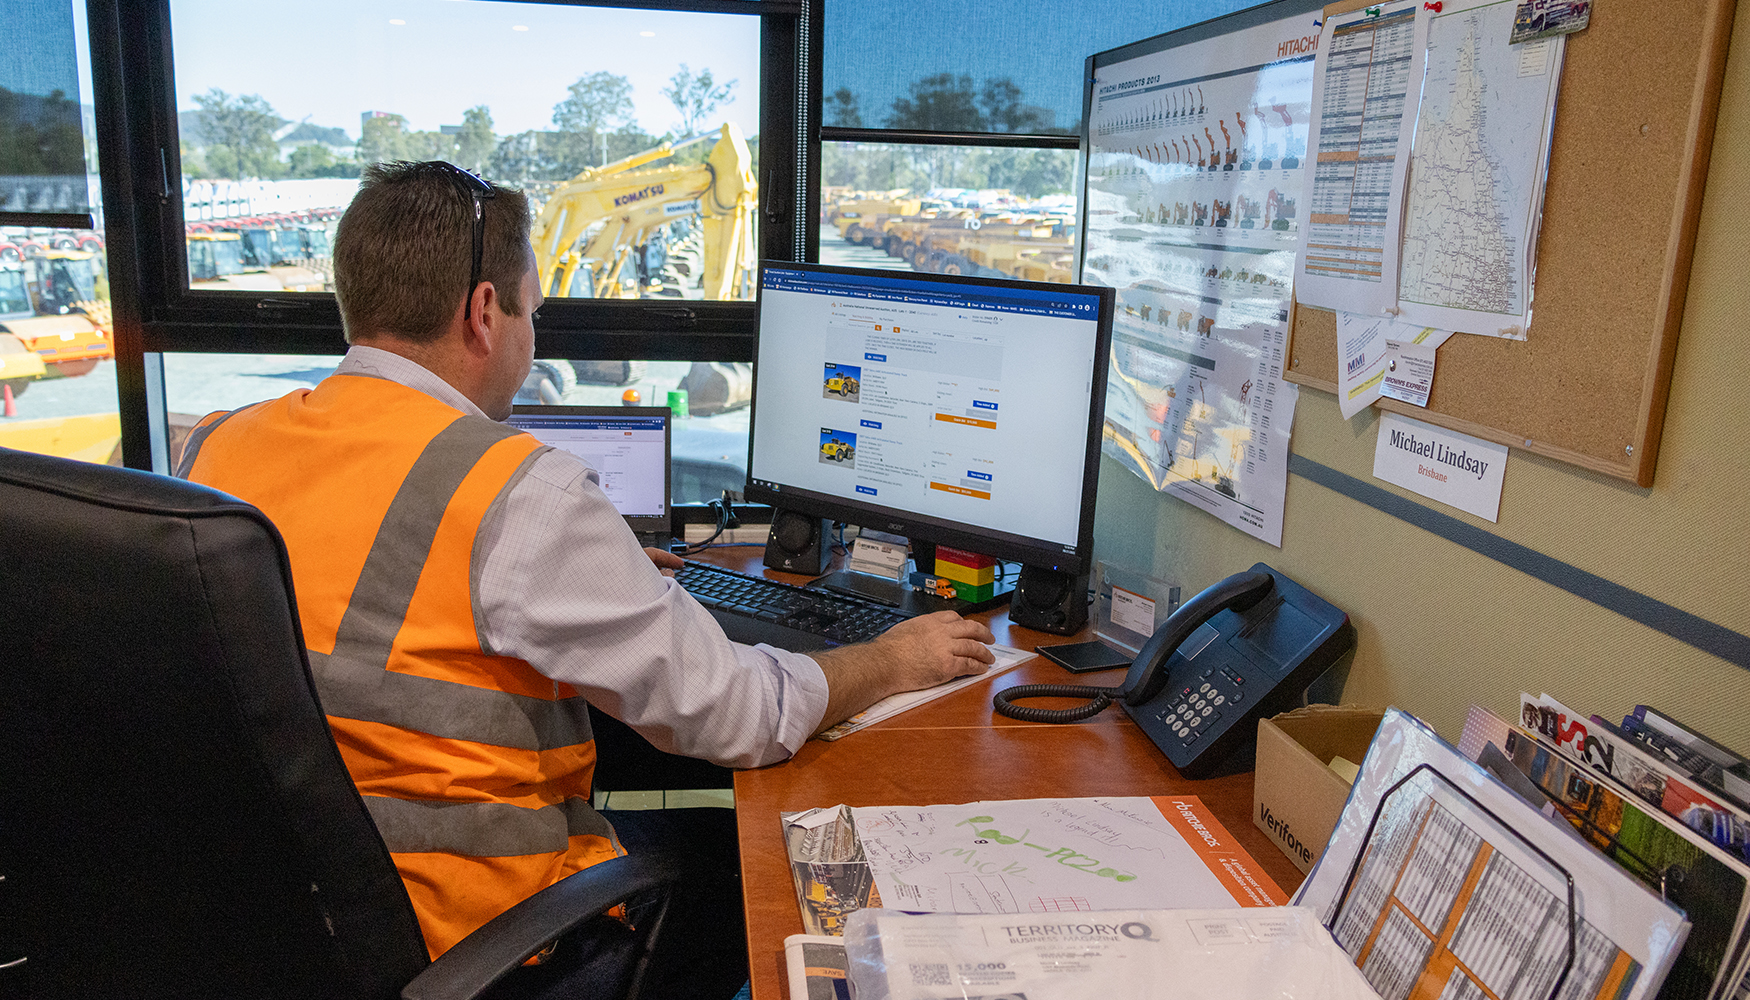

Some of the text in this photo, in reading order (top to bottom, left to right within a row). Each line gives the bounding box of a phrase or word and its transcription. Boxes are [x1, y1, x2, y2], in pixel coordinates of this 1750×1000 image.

[1277, 34, 1320, 58] HITACHI
[1118, 78, 1145, 90] PRODUCTS
[1146, 74, 1160, 85] 2013
[614, 184, 664, 207] KOMATSU
[1406, 382, 1428, 392] EXPRESS
[1390, 429, 1488, 480] Michael Lindsay
[1418, 464, 1448, 482] Brisbane
[1260, 802, 1310, 864] Verifone
[1009, 935, 1121, 944] BUSINESS MAGAZINE
